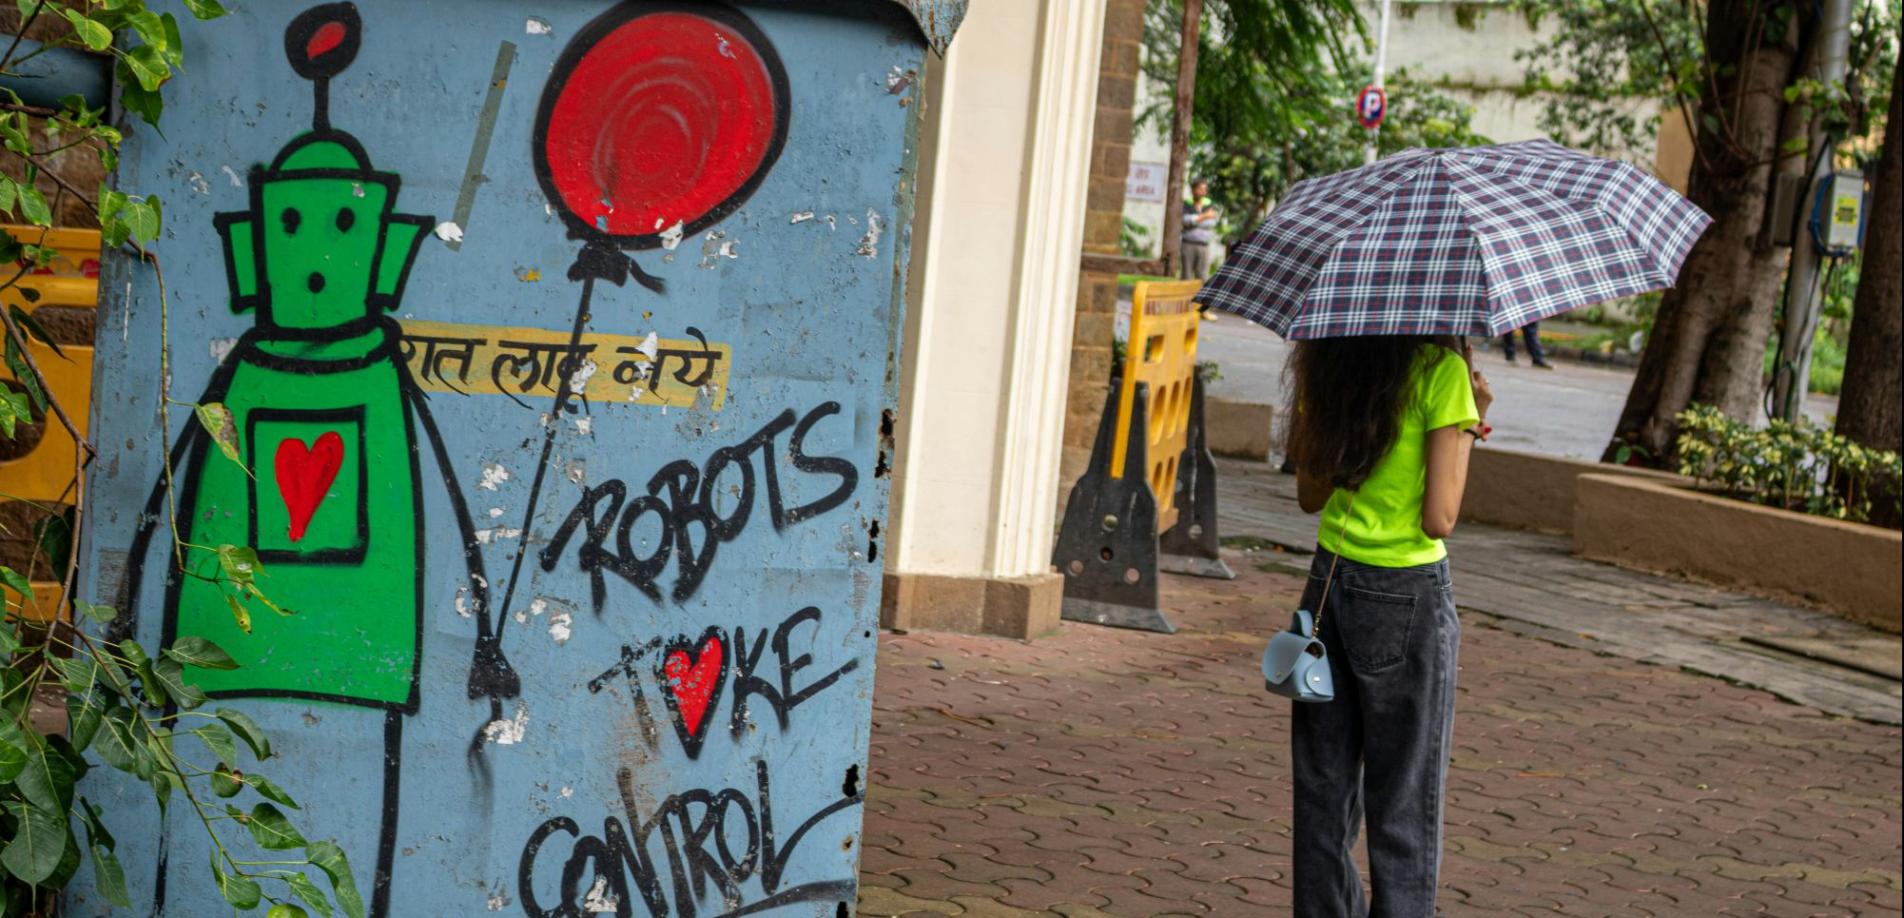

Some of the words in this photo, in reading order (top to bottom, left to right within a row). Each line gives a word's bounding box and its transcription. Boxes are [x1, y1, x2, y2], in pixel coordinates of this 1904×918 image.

[1363, 92, 1381, 119] P
[612, 326, 722, 401] नये
[539, 401, 858, 616] ROBOTS
[588, 606, 858, 760] TKE
[518, 759, 864, 918] CONTROL
